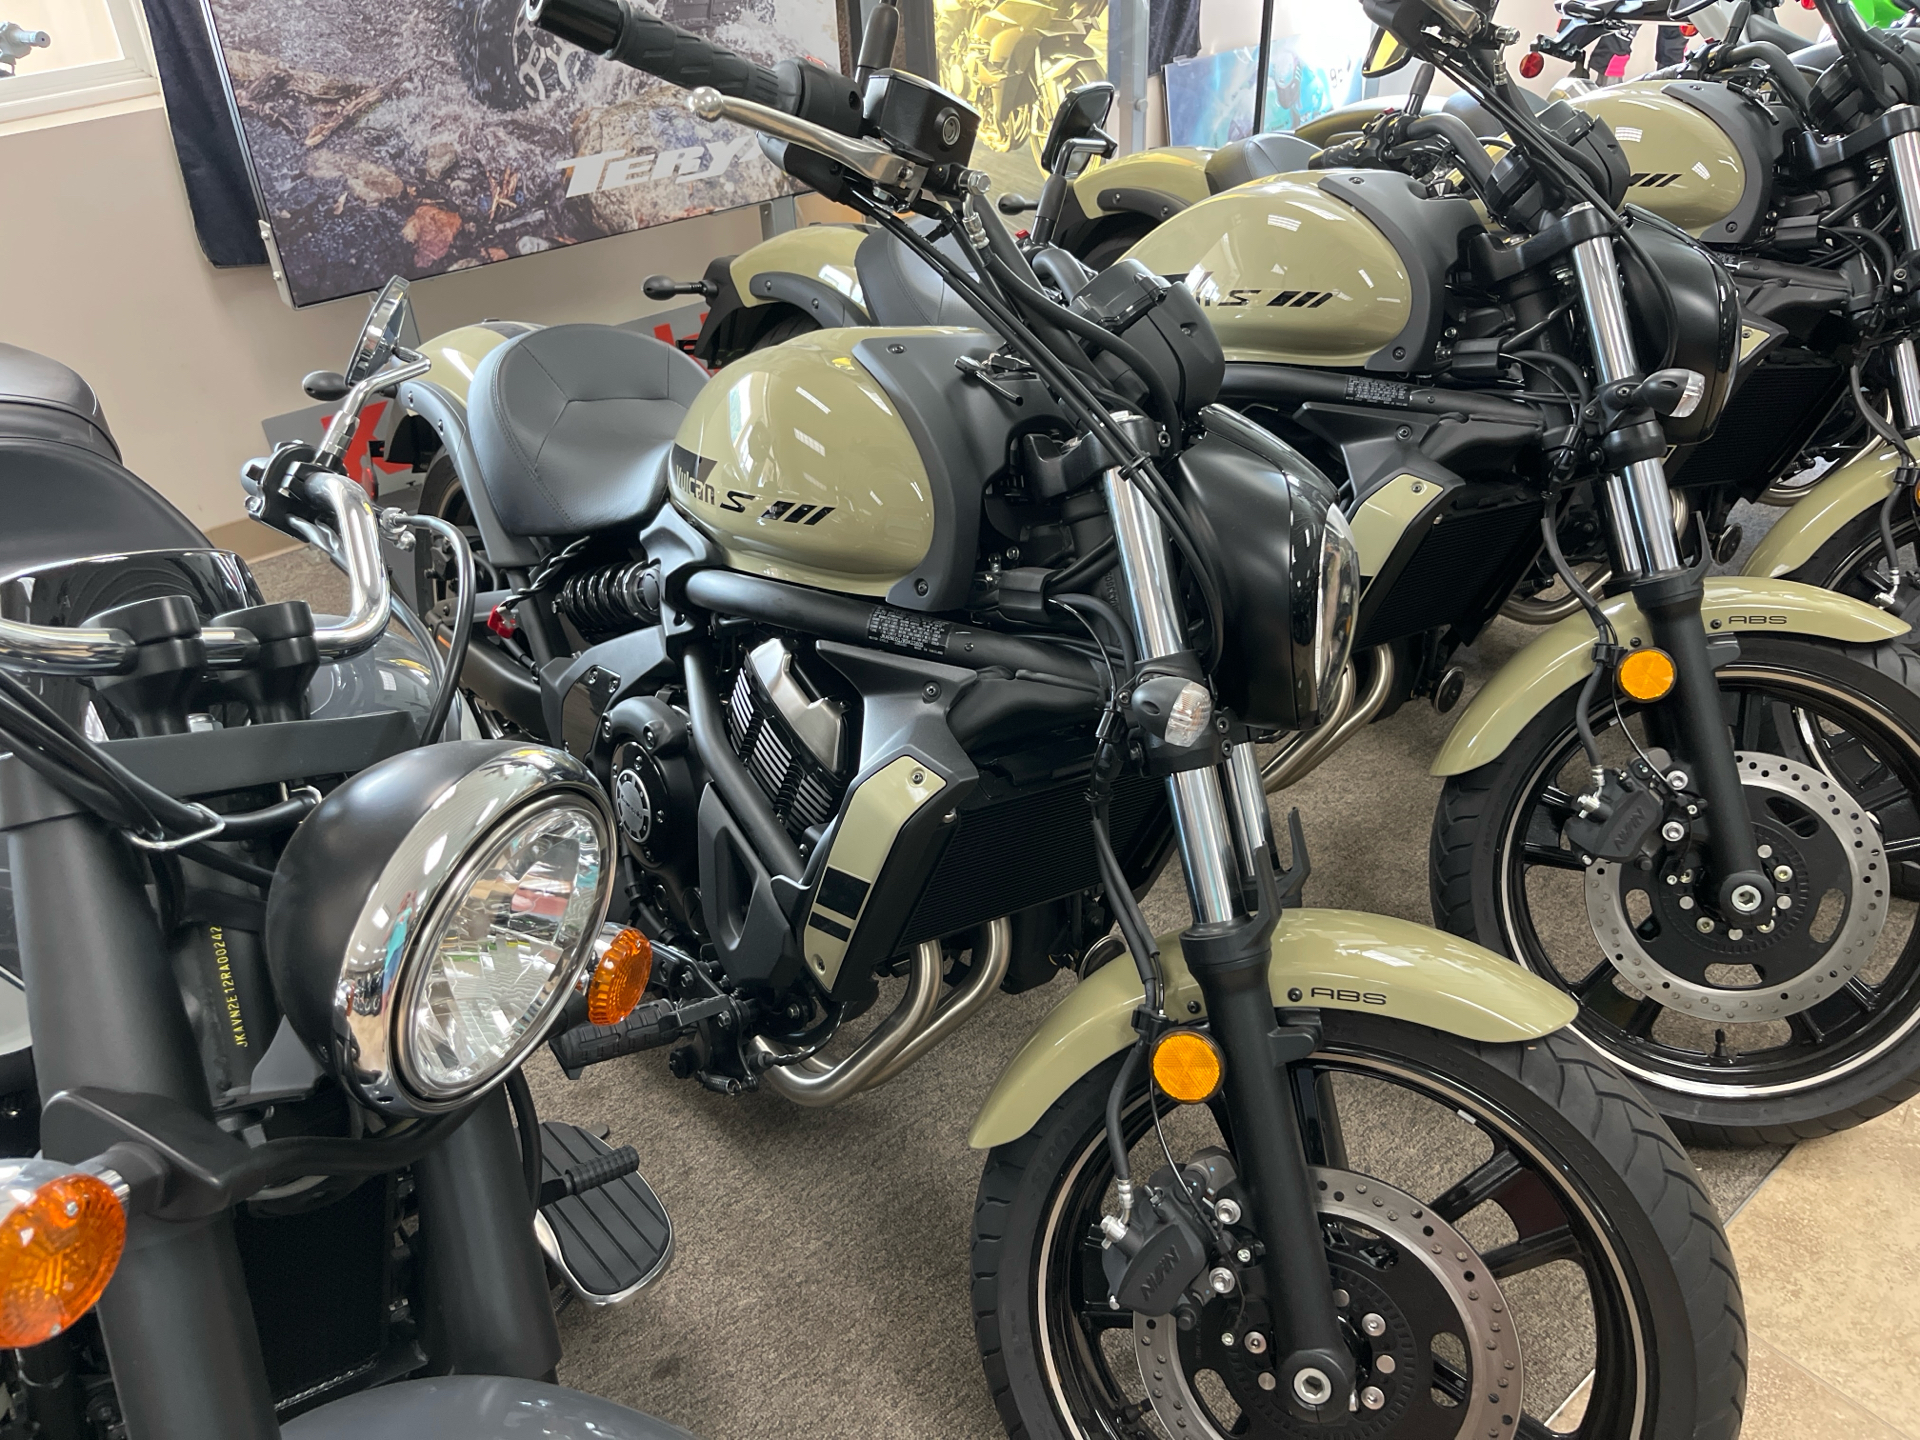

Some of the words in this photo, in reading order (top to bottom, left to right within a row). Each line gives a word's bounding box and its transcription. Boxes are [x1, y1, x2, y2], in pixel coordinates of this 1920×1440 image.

[676, 464, 716, 506] Vulcan
[719, 490, 757, 513] S
[1728, 615, 1788, 625] ABS
[1310, 986, 1387, 1005] ABS
